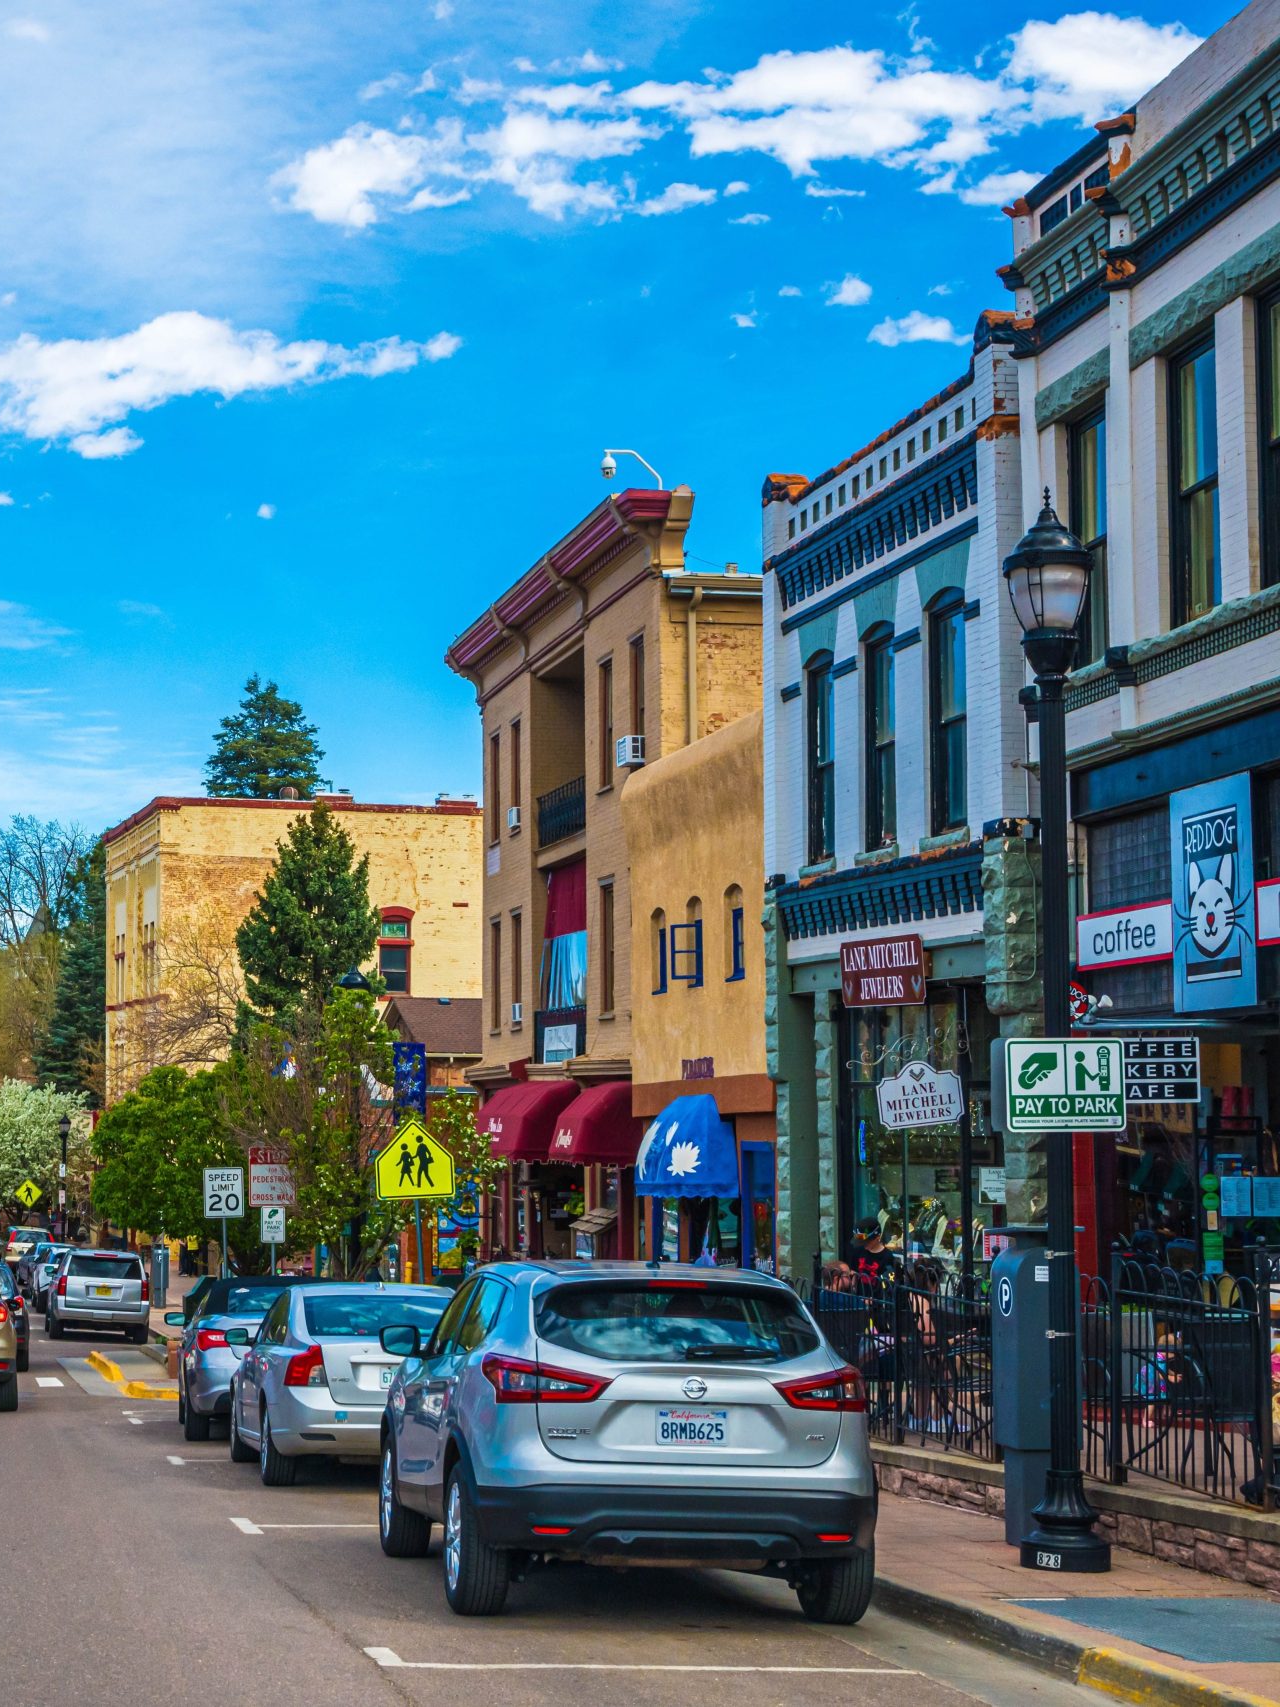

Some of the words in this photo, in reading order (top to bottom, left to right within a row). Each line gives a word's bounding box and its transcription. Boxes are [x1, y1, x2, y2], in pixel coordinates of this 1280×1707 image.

[1184, 824, 1204, 855] RED
[1205, 816, 1236, 850] DOG
[1092, 918, 1156, 955] coffee
[842, 948, 866, 972] LANE
[868, 941, 919, 970] MITCHELL
[860, 975, 904, 1000] JEWELERS
[1070, 987, 1087, 1002] DOG
[1129, 1043, 1192, 1057] FFEE
[1127, 1063, 1193, 1078] KERY
[902, 1081, 937, 1097] LANE
[1129, 1085, 1175, 1098] AFE
[886, 1093, 956, 1112] MITCHELL
[1015, 1098, 1045, 1114] PAY
[1049, 1098, 1071, 1114] TO
[1075, 1097, 1118, 1113] PARK
[892, 1107, 952, 1123] JEWELERS
[208, 1173, 239, 1182] SPEED
[252, 1175, 292, 1183] PEDESTRIA
[211, 1184, 235, 1192] LIMIT
[208, 1193, 239, 1212] 20
[1001, 1283, 1010, 1309] P
[671, 1410, 710, 1421] California
[548, 1426, 591, 1435] ROGUE
[661, 1421, 724, 1441] 8RMB625
[1038, 1553, 1060, 1567] 828
